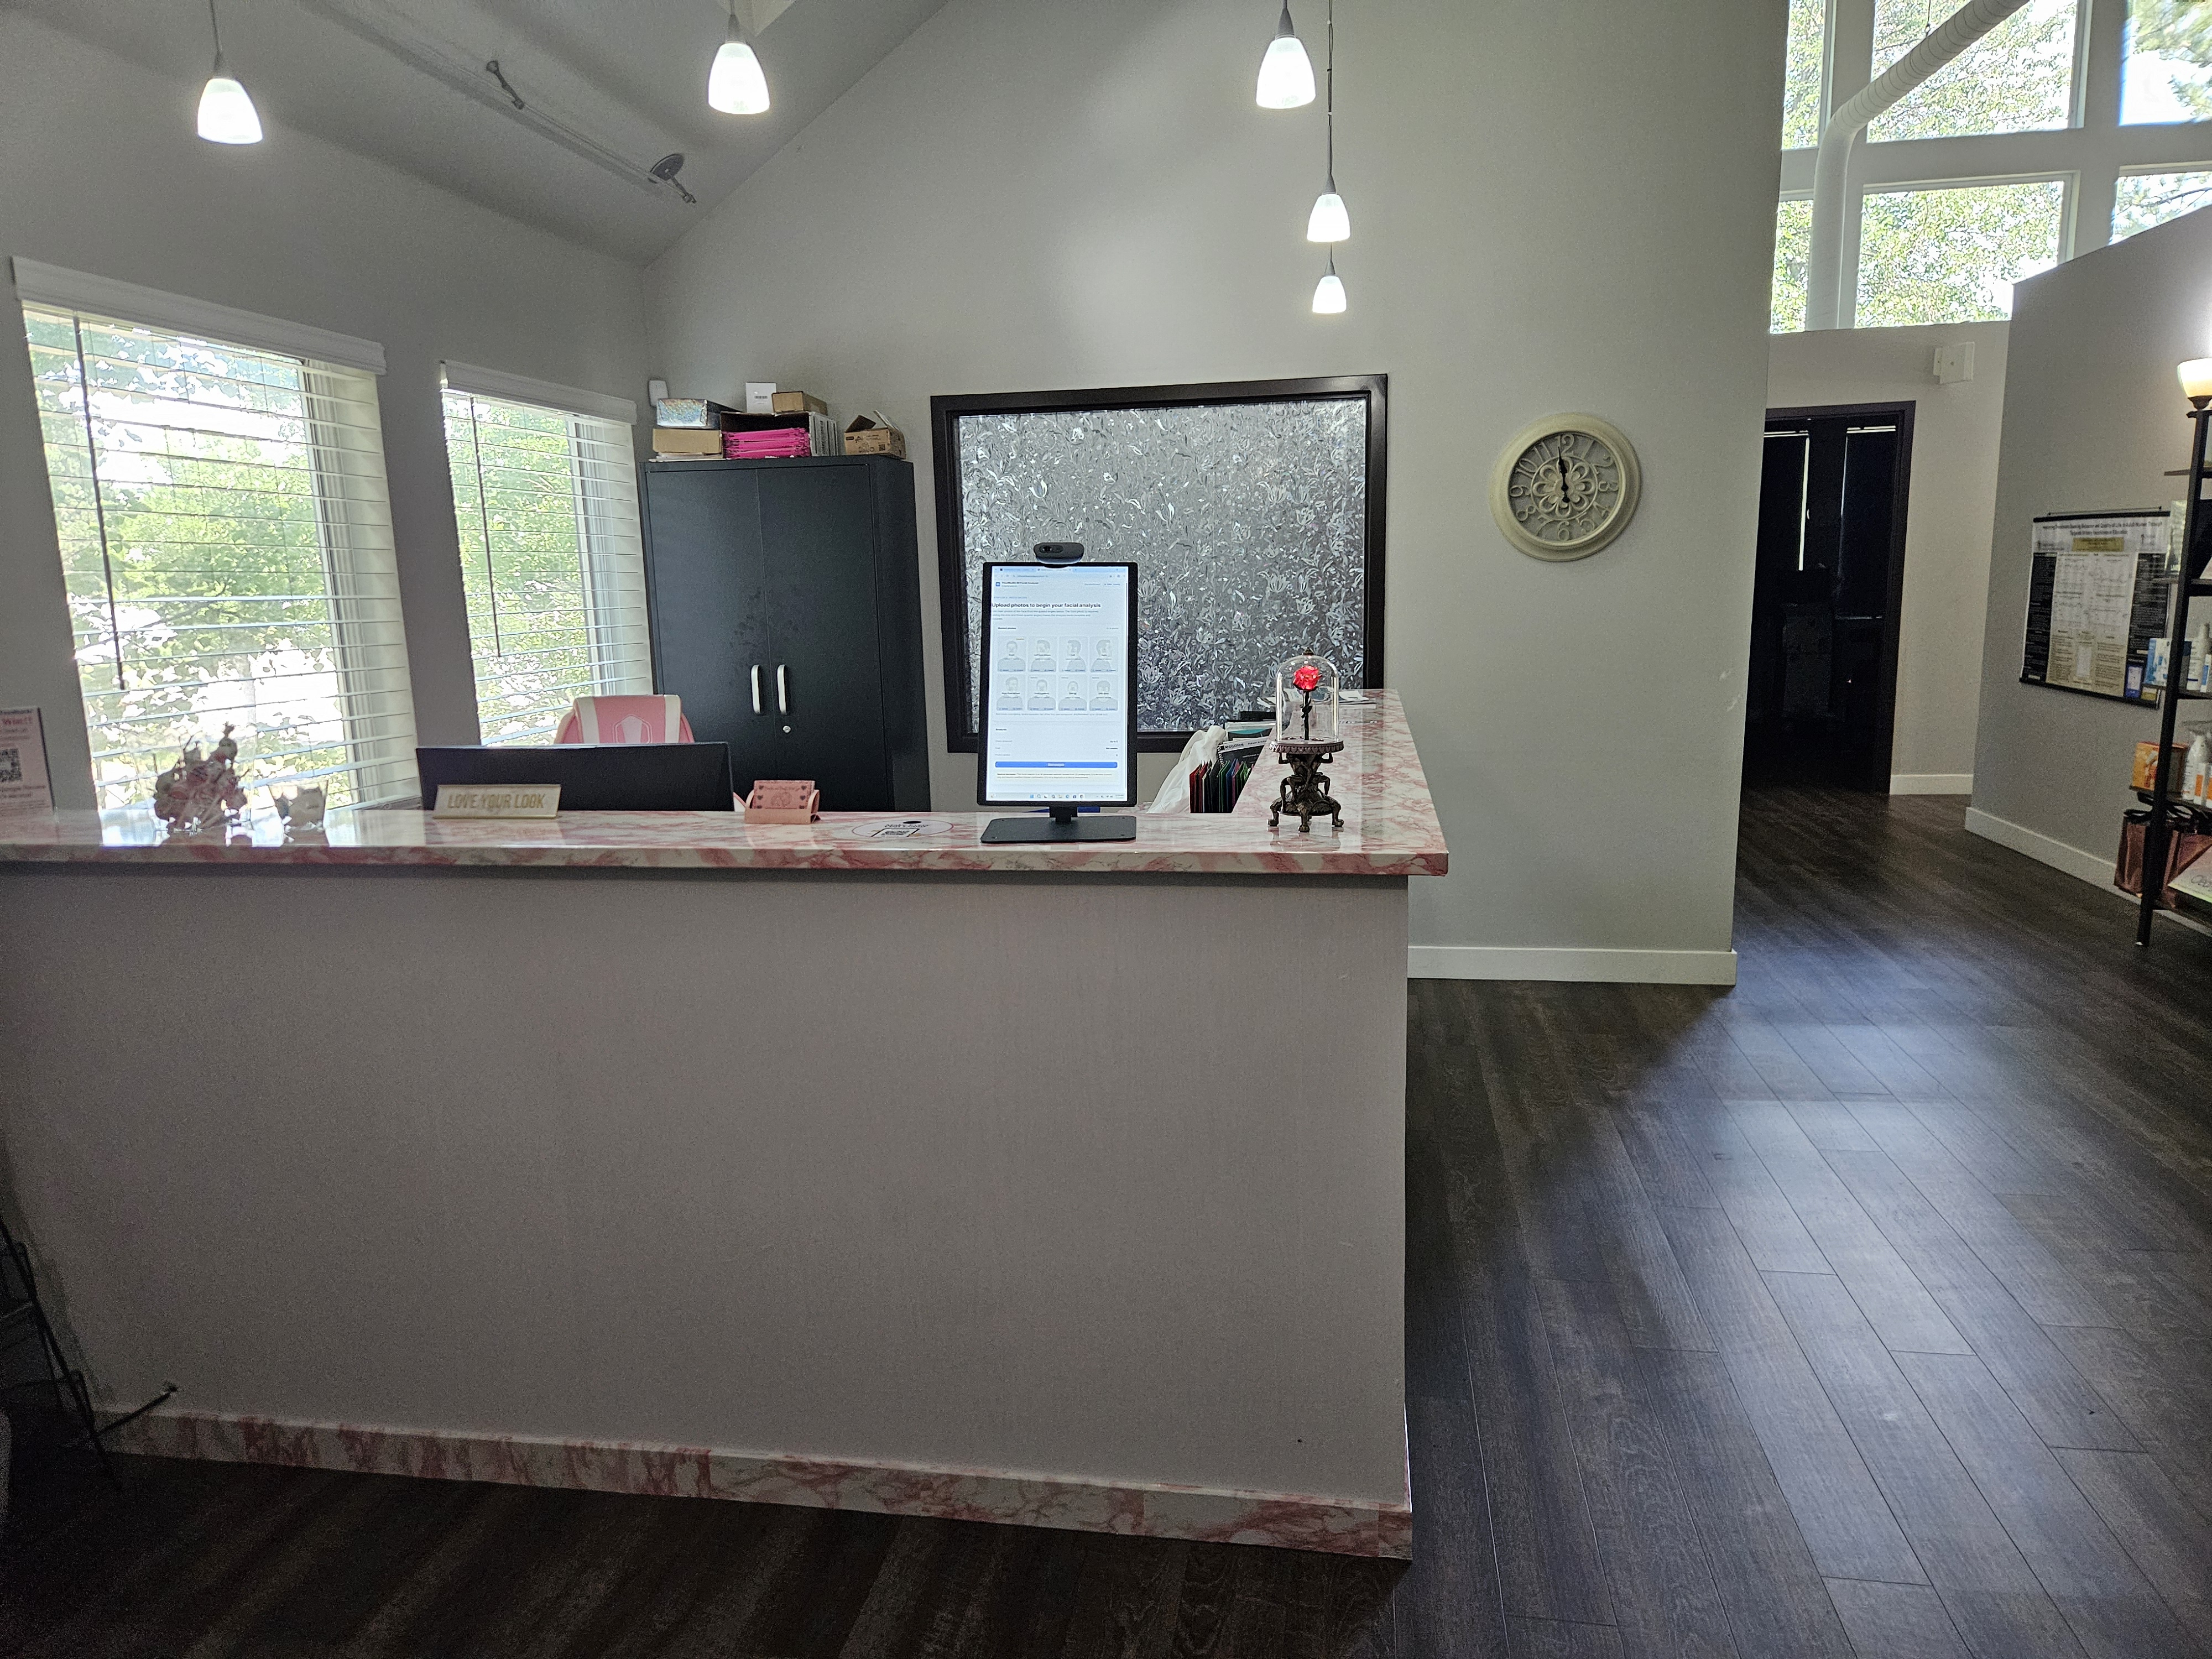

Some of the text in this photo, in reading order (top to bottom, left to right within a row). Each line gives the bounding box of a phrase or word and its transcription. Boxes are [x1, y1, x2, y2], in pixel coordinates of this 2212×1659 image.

[1556, 433, 1575, 456] 12
[1509, 484, 1530, 498] 9
[1598, 479, 1619, 494] 3
[1516, 504, 1537, 521] 8
[1557, 521, 1570, 541] 6
[447, 794, 546, 808] LOVE YOUR LOOK
